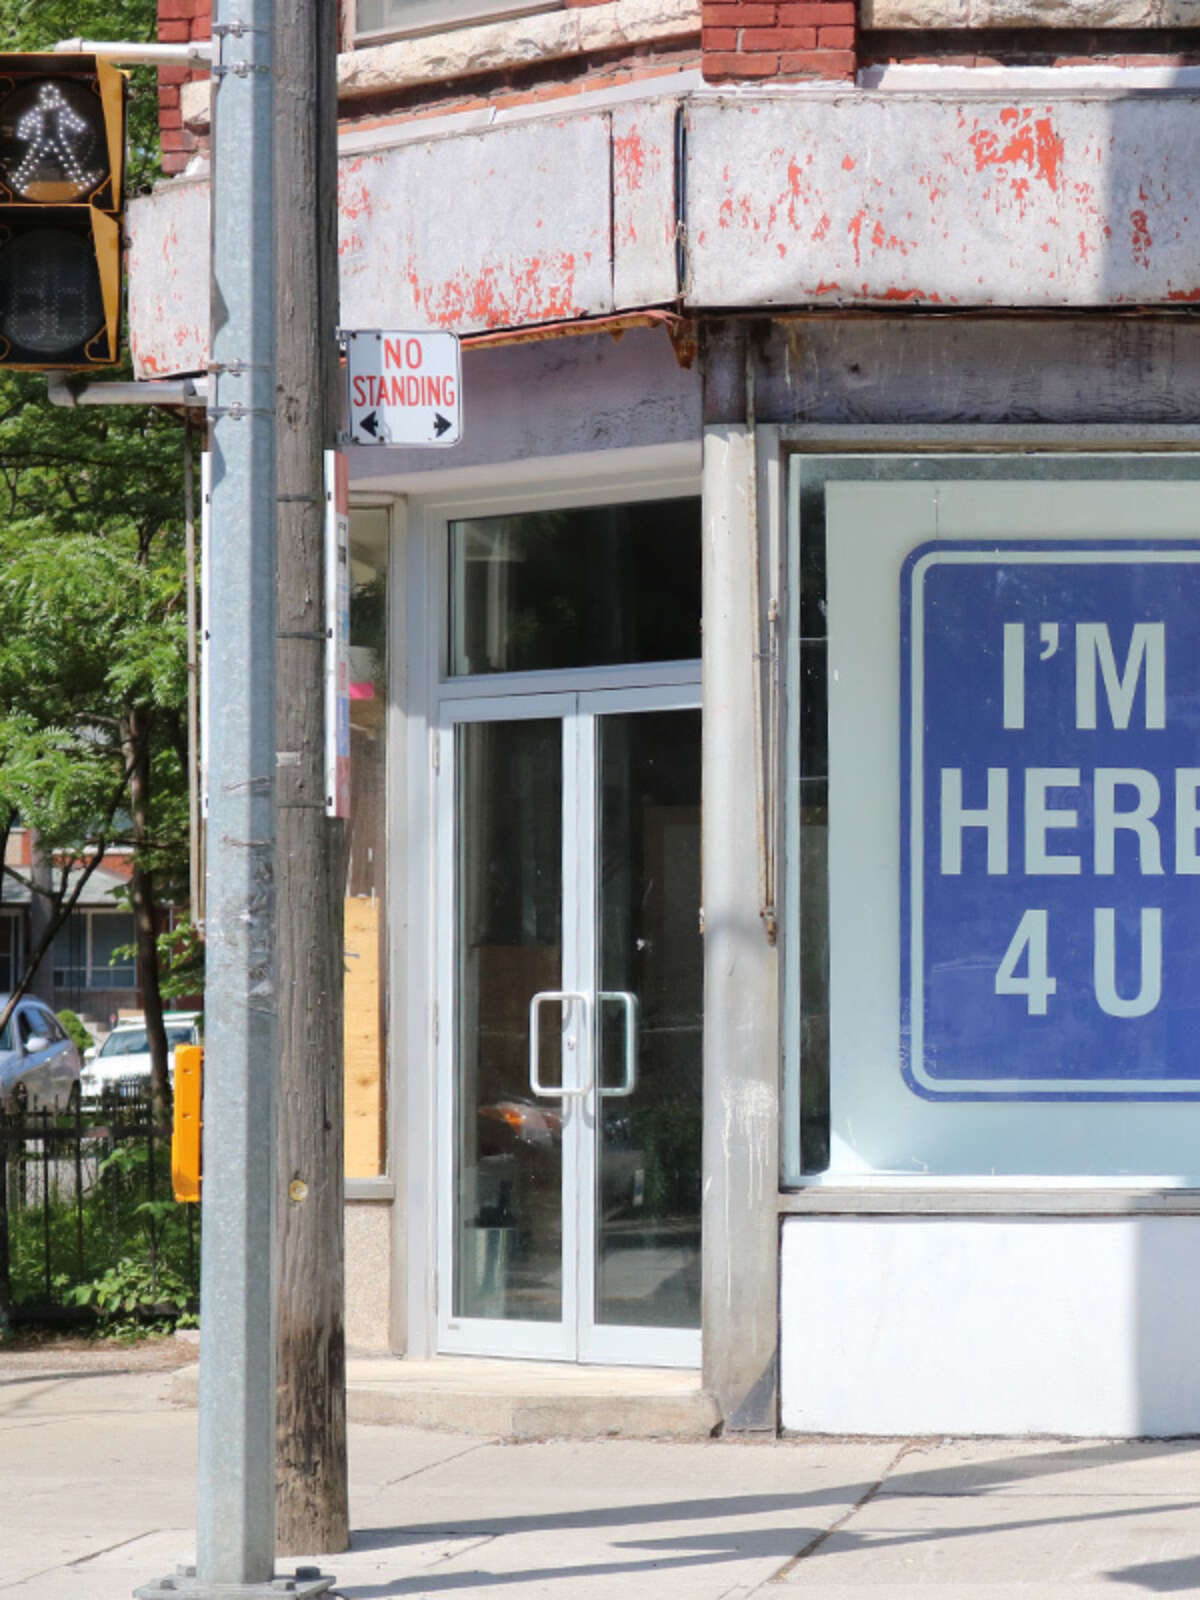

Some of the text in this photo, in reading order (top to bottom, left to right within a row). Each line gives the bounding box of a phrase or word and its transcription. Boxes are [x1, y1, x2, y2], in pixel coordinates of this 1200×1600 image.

[384, 338, 423, 370] NO
[353, 375, 455, 407] STANDING
[995, 907, 1163, 1019] 4 U
